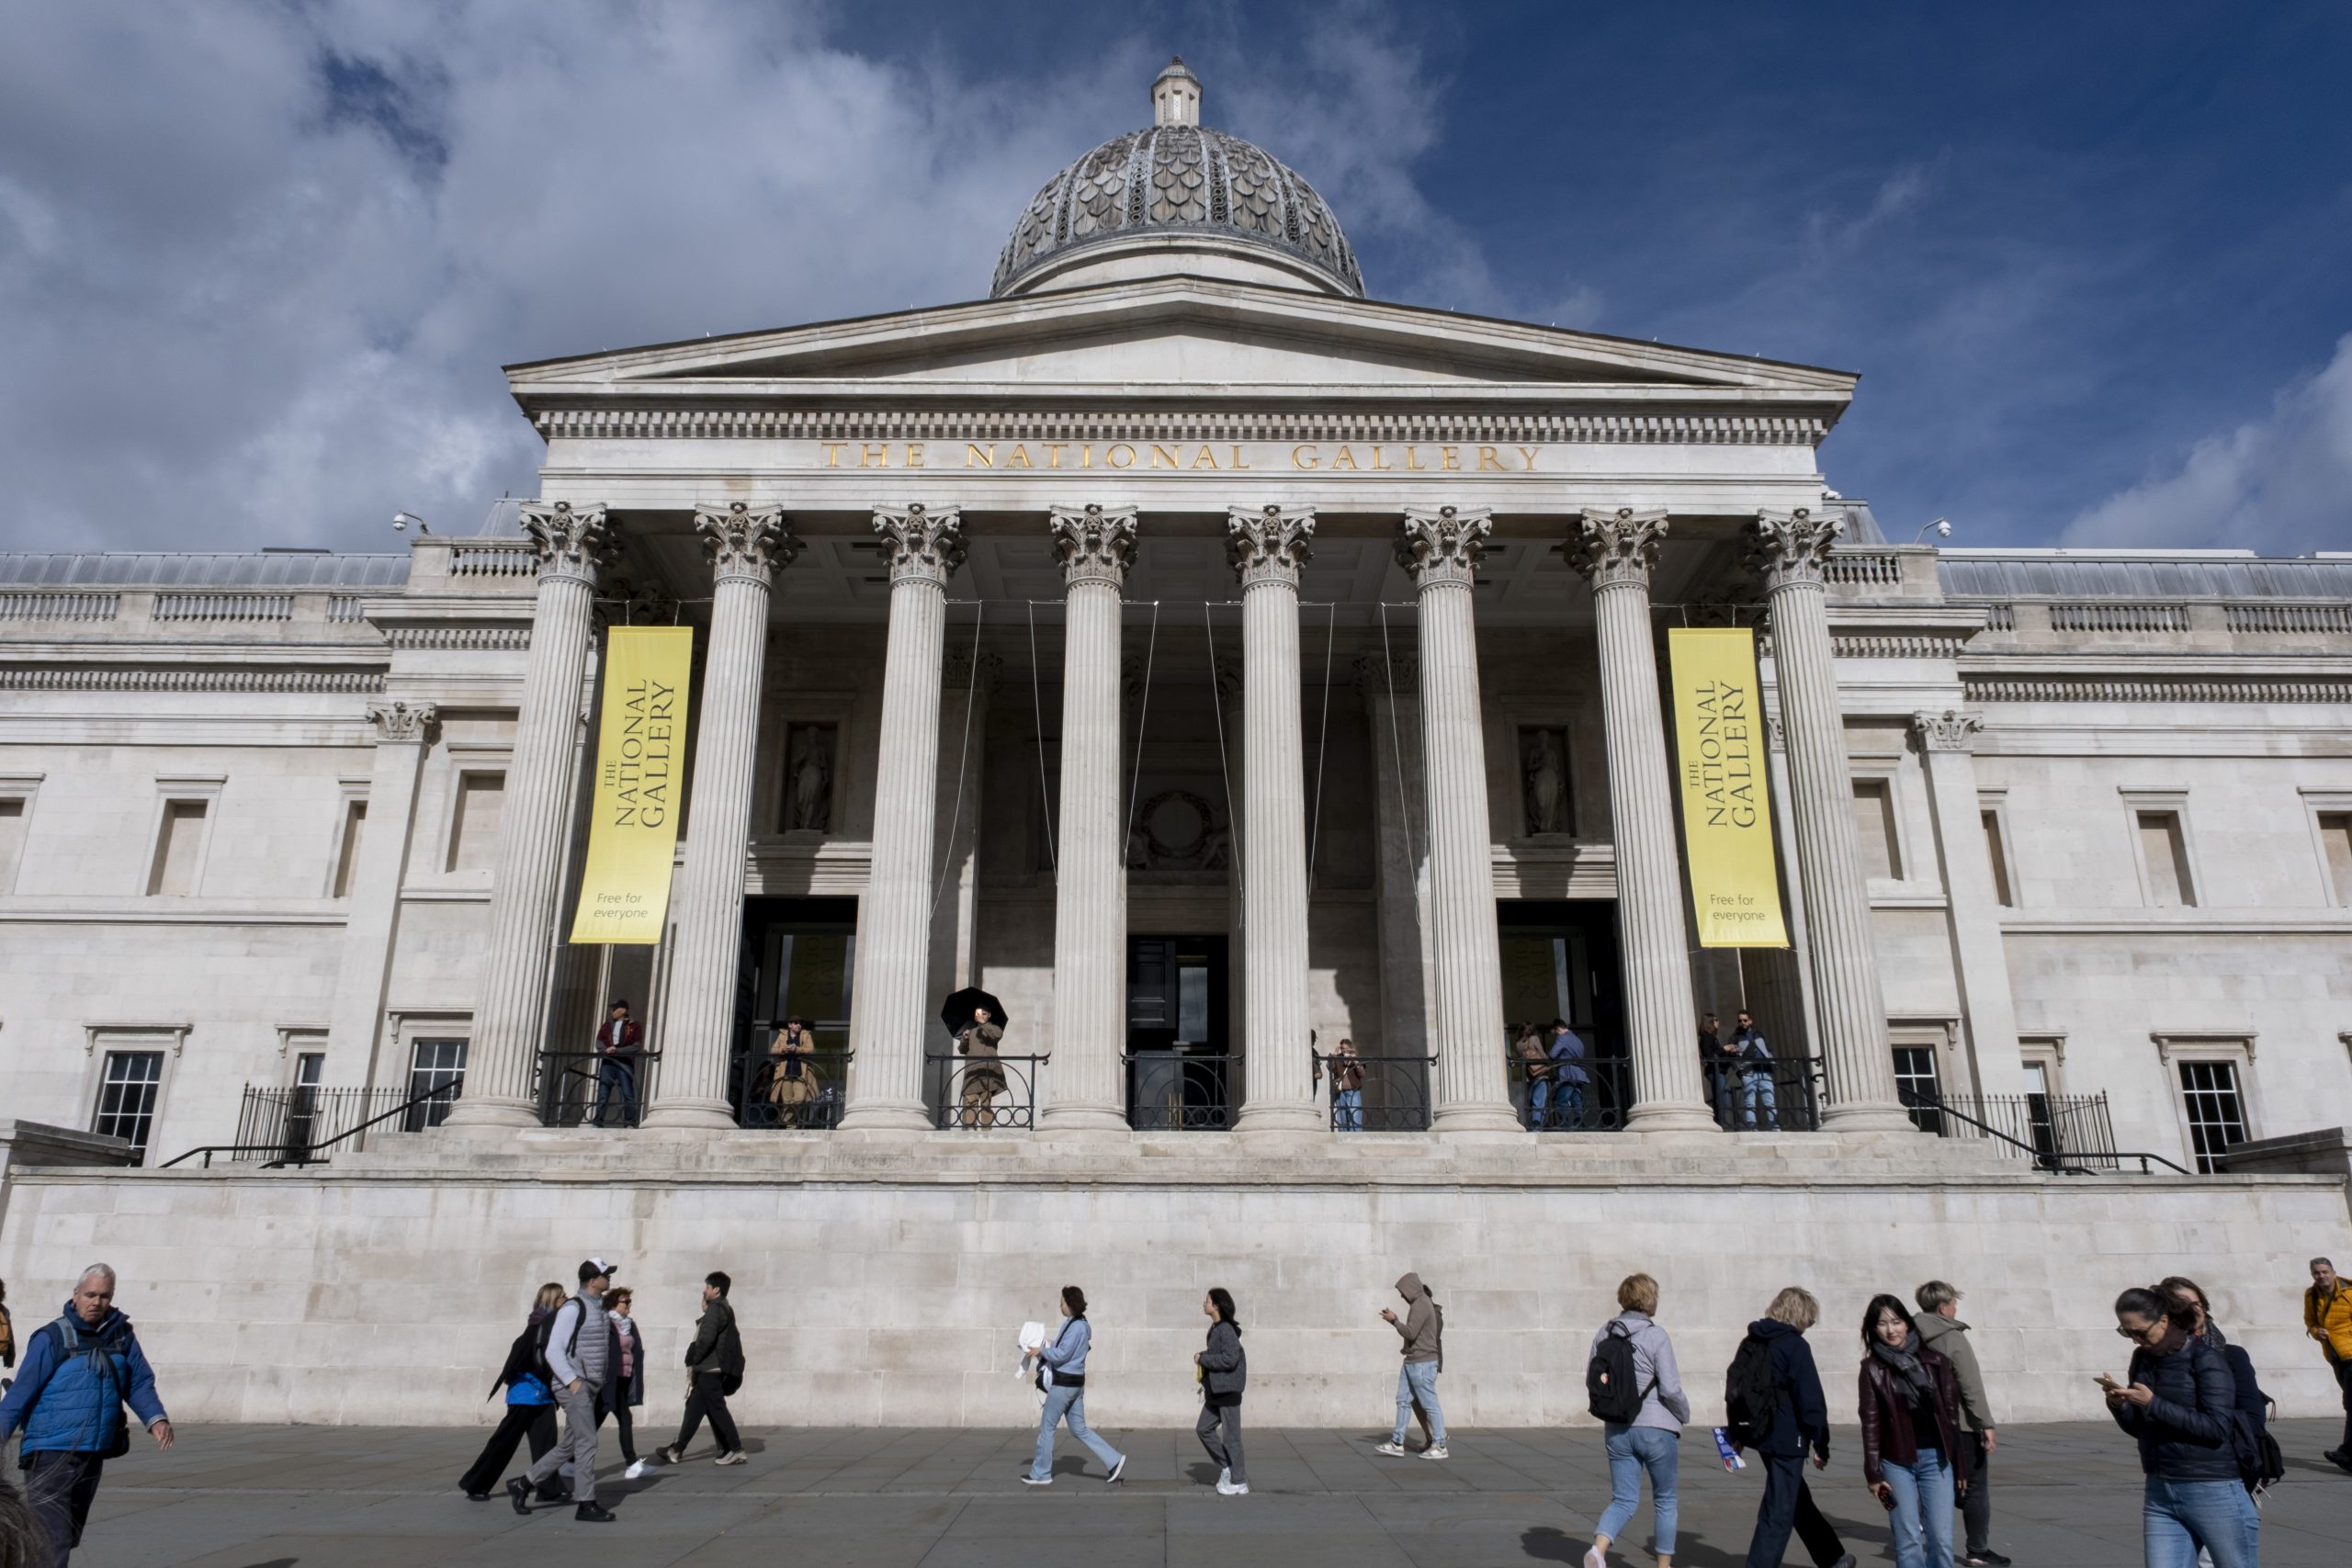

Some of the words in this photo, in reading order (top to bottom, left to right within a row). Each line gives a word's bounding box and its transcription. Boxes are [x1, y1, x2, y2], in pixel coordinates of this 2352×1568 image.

[820, 442, 925, 468] THE
[963, 443, 1250, 469] NATIONAL
[1292, 445, 1544, 471] GALLERY
[615, 679, 647, 828] NATIONAL
[640, 680, 674, 829] GALLERY
[1696, 680, 1727, 828] NATIONAL
[1720, 680, 1756, 829] GALLERY
[605, 760, 616, 789] THE
[1689, 760, 1700, 789] THE
[597, 893, 622, 903] Free
[626, 892, 642, 903] for
[1710, 894, 1735, 905] Free
[1737, 894, 1755, 905] for
[594, 909, 649, 920] everyone
[1713, 911, 1766, 923] everyone
